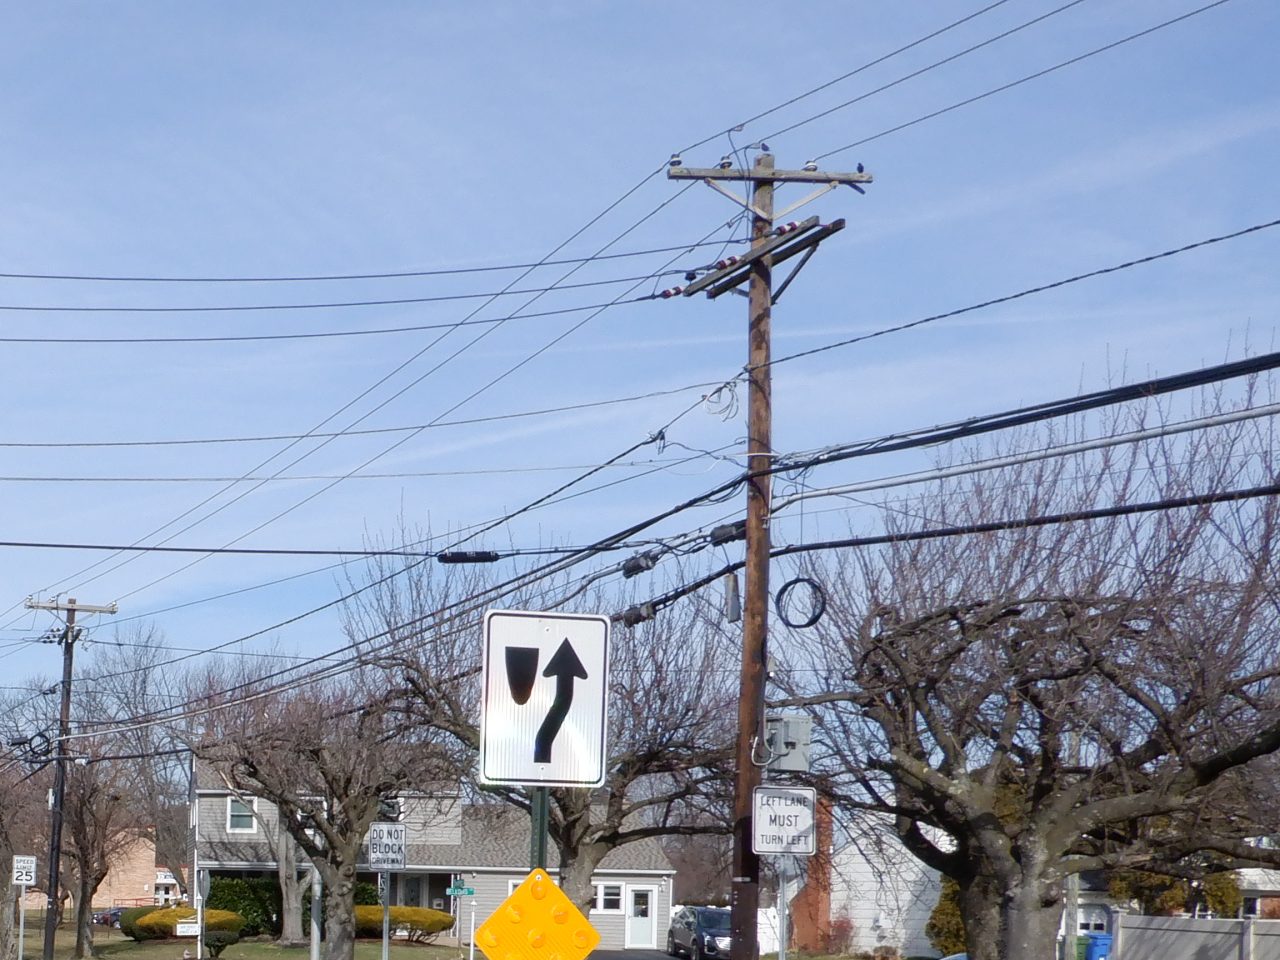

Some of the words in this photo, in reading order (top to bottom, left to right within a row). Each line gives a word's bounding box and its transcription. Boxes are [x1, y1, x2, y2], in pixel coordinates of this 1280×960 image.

[760, 797, 781, 806] LEFT
[784, 797, 808, 806] LANE
[769, 814, 799, 827] MUST
[372, 829, 384, 840] DO
[387, 829, 404, 840] NOT
[760, 834, 783, 845] TURN
[786, 835, 808, 845] LEFT
[372, 843, 403, 854] BLOCK
[372, 857, 404, 865] DRIVEWAY
[15, 871, 33, 882] 25
